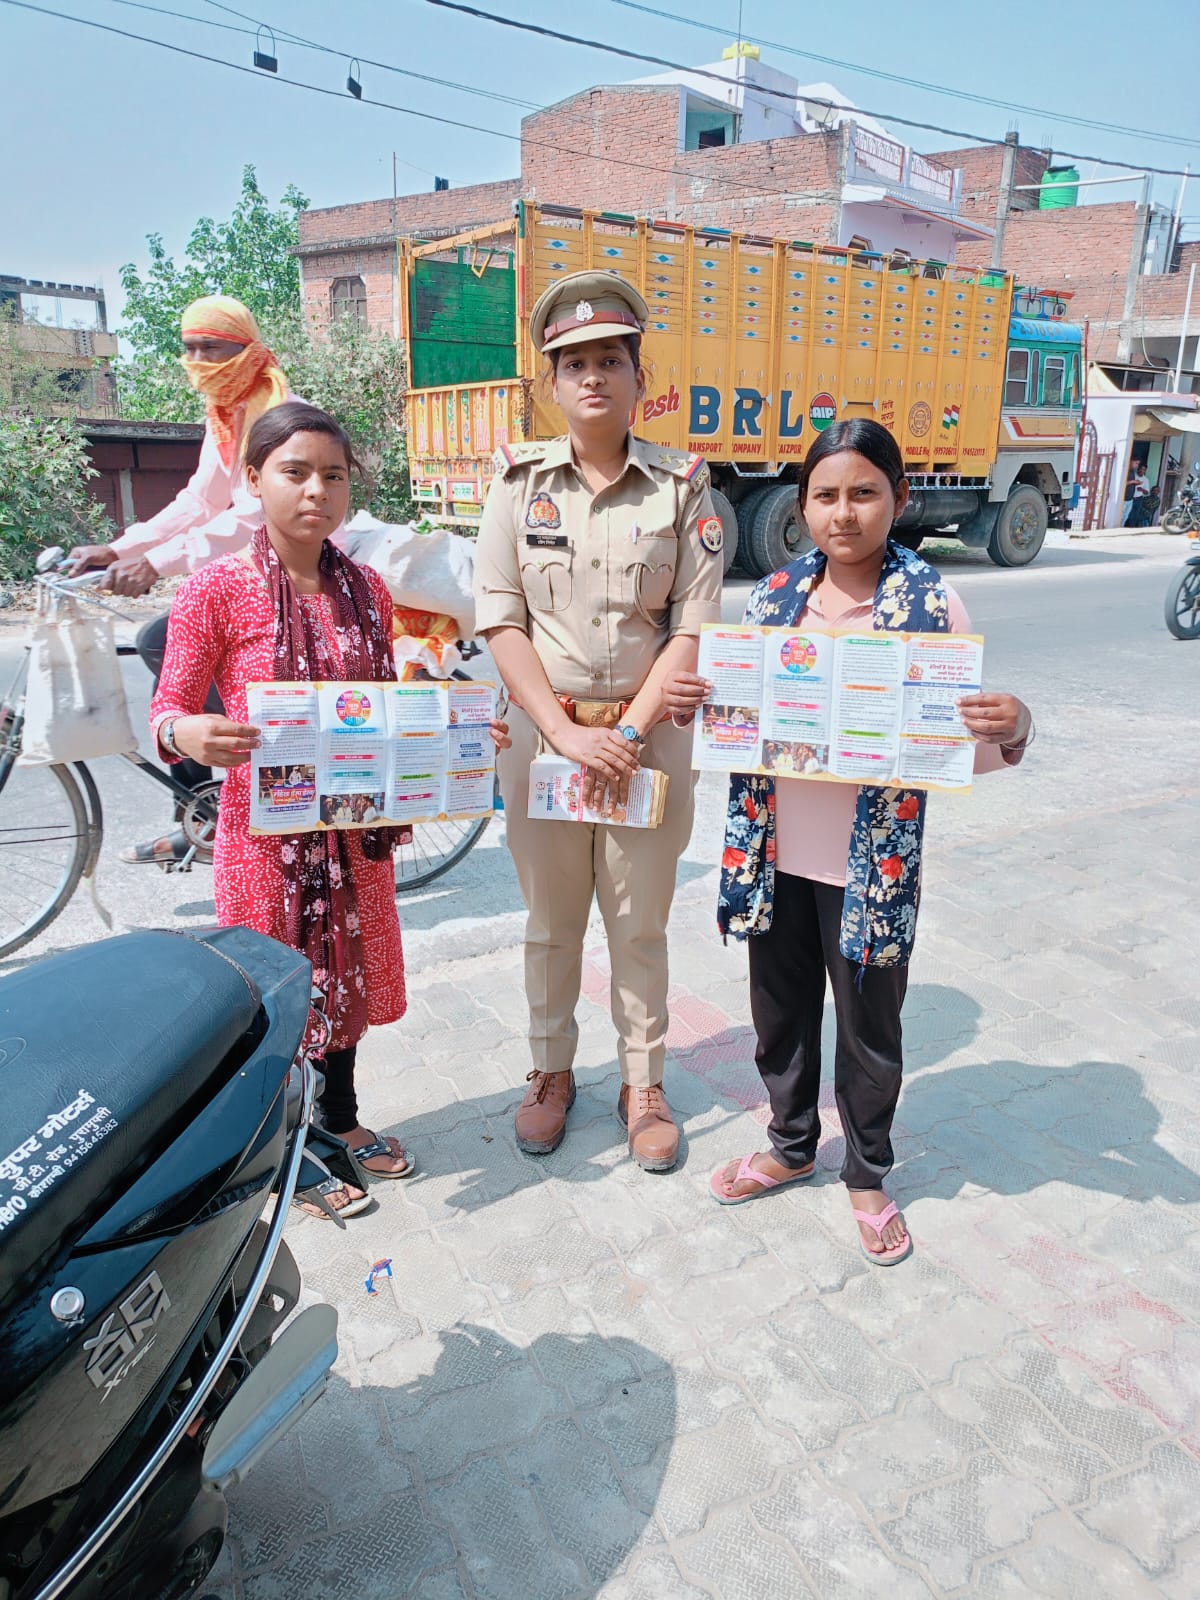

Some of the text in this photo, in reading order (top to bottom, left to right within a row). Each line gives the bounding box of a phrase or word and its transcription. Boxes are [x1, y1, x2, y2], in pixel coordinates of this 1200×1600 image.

[687, 441, 802, 455] RANSPORT OMPANY AIZPUR
[37, 1088, 96, 1139] मोटर्स
[63, 1118, 118, 1167] 9415645383
